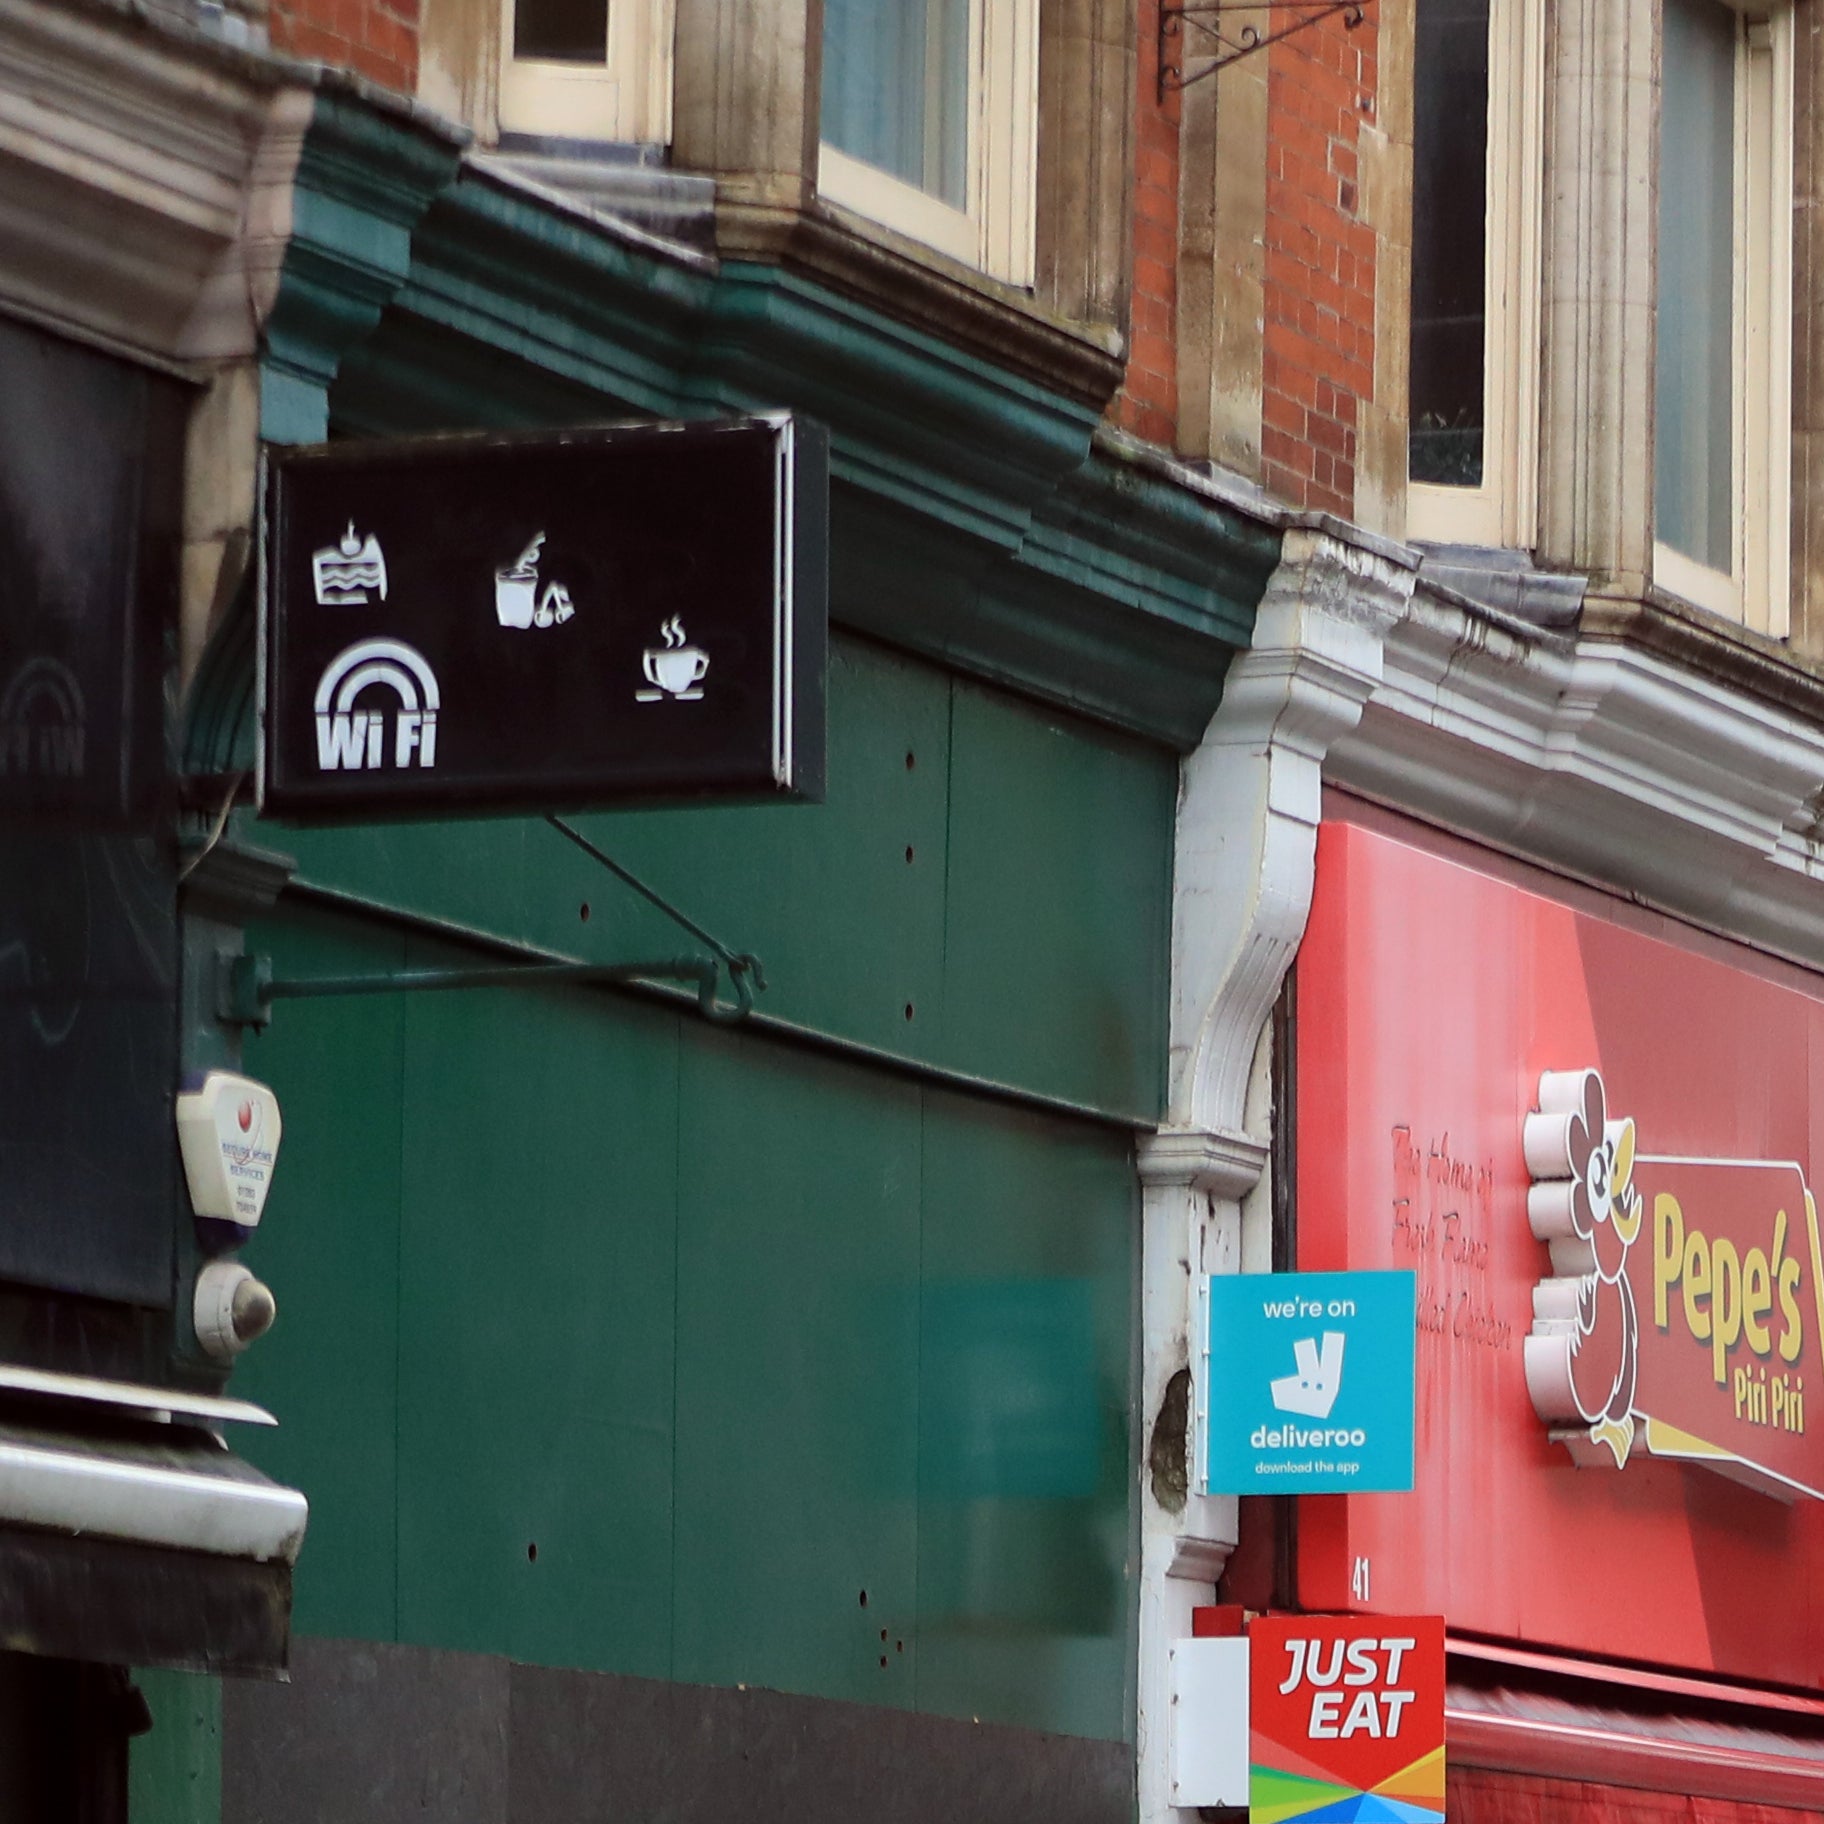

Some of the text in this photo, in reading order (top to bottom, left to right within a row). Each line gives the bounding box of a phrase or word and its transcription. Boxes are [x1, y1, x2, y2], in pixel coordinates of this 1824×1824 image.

[1264, 1296, 1355, 1318] we're on
[1654, 1192, 1802, 1383] Pepe's
[1734, 1366, 1803, 1434] Piri Piri
[1250, 1425, 1366, 1449] deliveroo
[1255, 1461, 1359, 1476] download the app
[1352, 1555, 1370, 1602] 41
[1279, 1638, 1415, 1695] JUST
[1308, 1691, 1416, 1739] EAT
